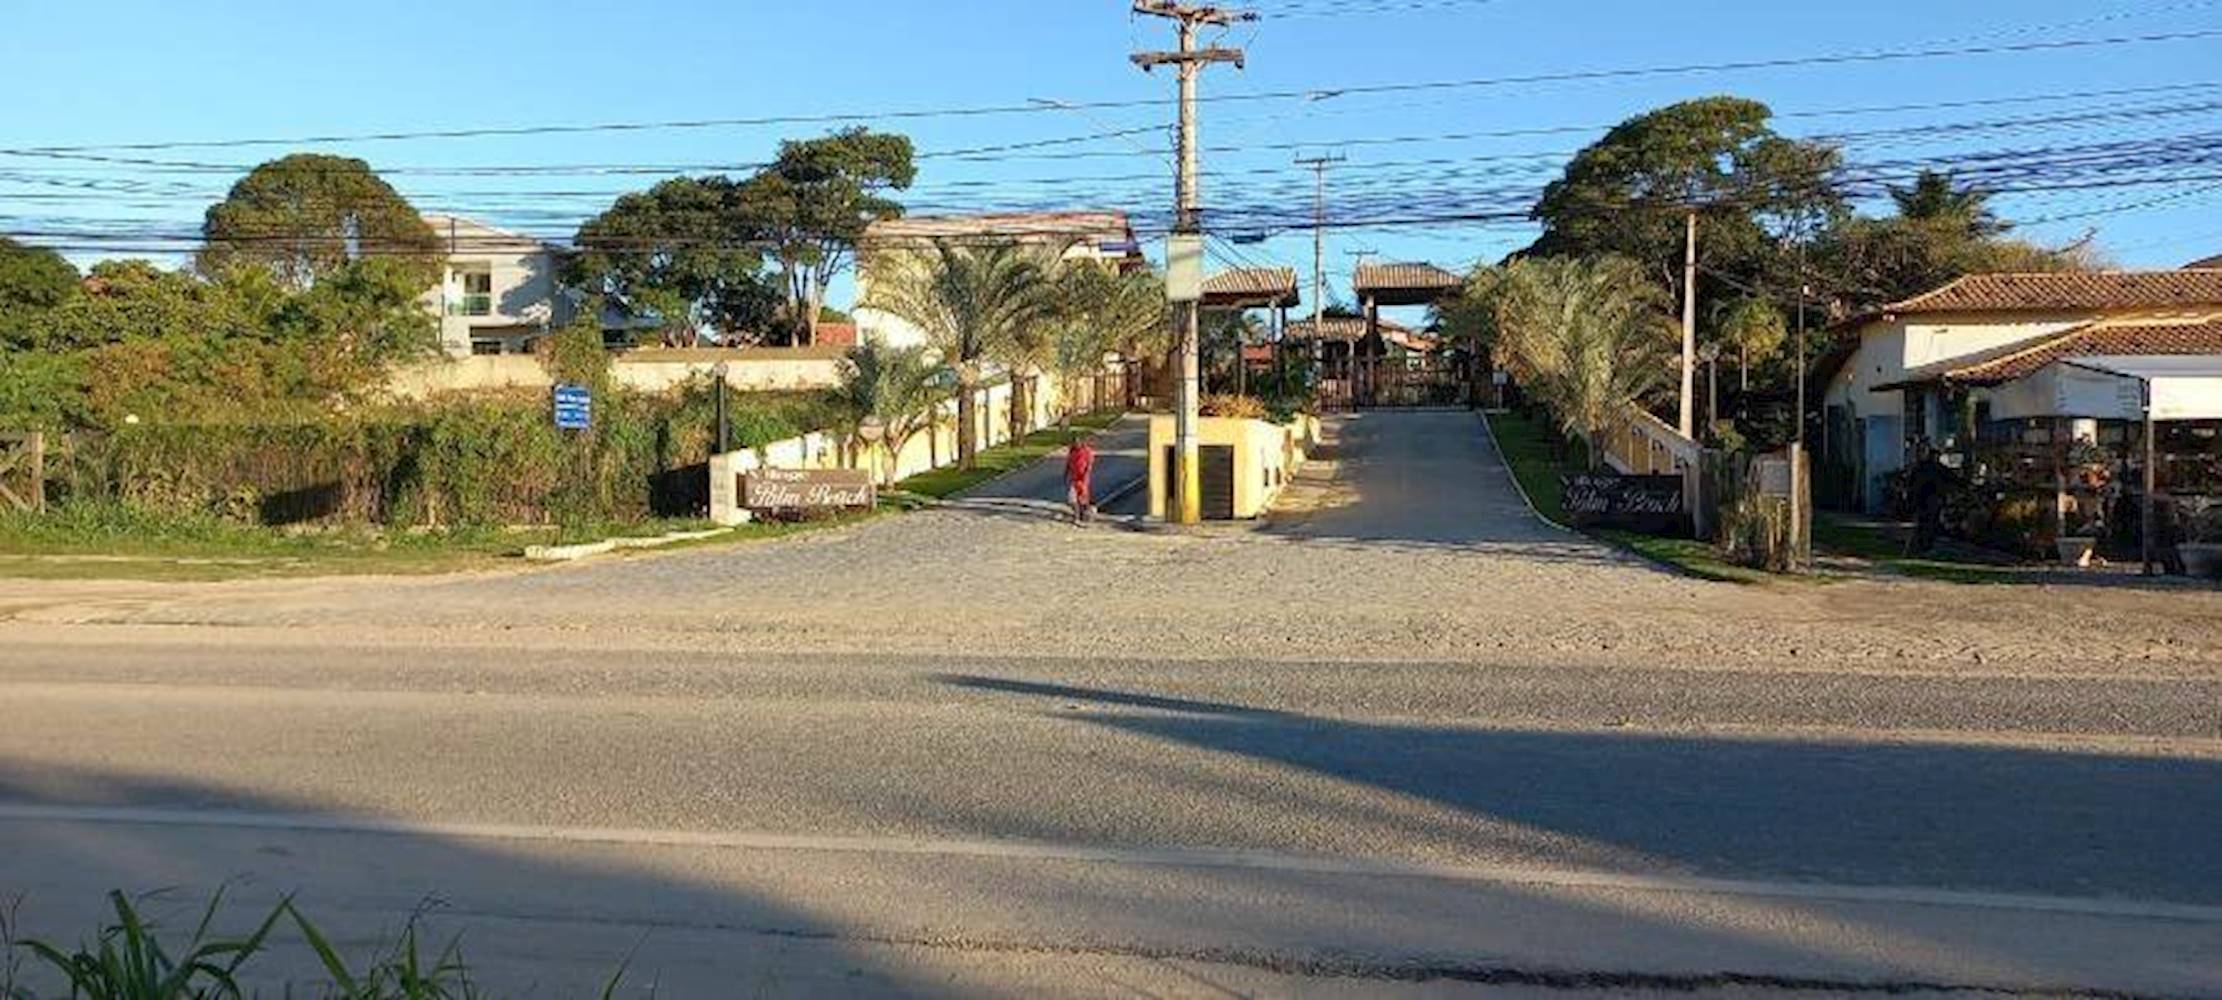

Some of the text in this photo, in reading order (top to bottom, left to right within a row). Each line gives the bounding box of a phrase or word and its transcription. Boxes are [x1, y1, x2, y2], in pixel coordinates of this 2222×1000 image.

[750, 482, 868, 507] Palm Beach
[1561, 485, 1680, 512] Palm Beach
